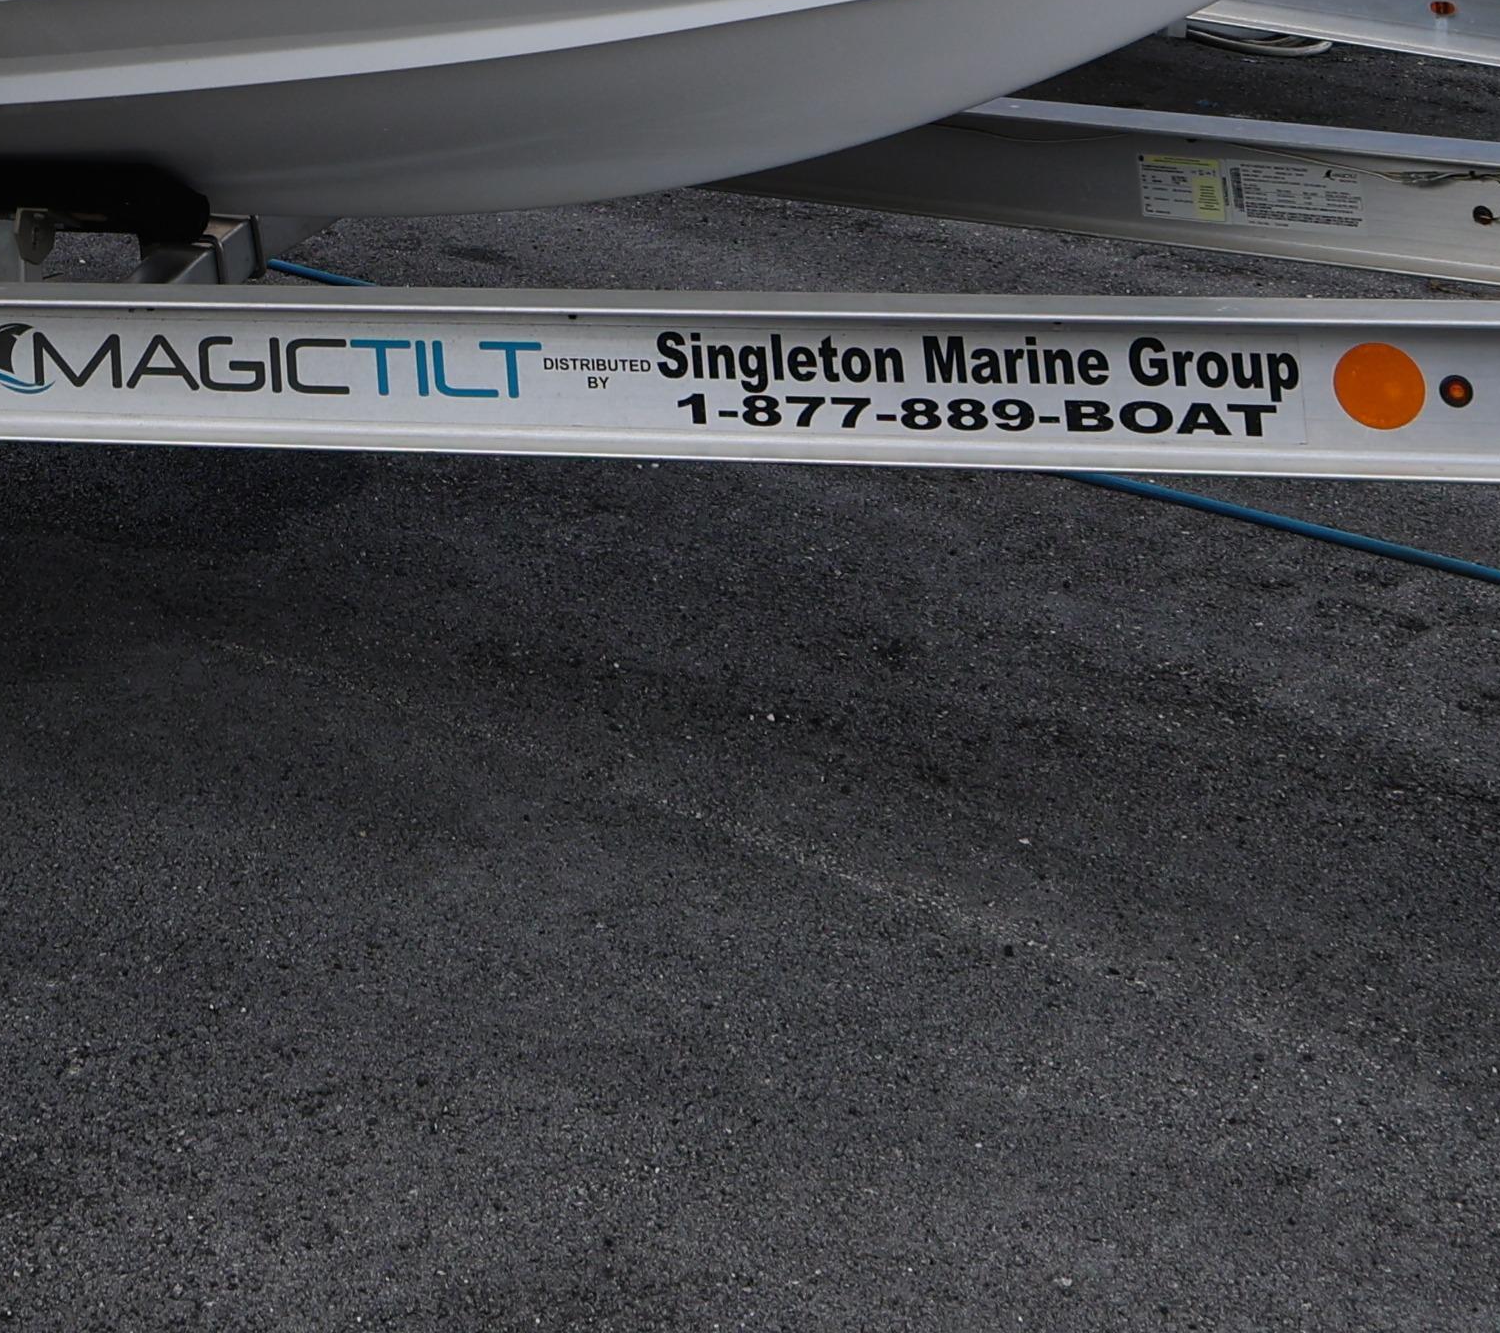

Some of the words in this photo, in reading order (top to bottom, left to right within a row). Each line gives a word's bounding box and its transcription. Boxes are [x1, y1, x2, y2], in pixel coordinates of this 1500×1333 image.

[33, 332, 542, 400] MAGICTILT
[543, 357, 652, 373] DISTRIBUTED
[587, 376, 609, 390] BY
[656, 331, 905, 393] Singleton
[922, 335, 1109, 385] Marine
[1128, 336, 1299, 402] Group
[677, 393, 1278, 437] 1-877-889-BOAT
